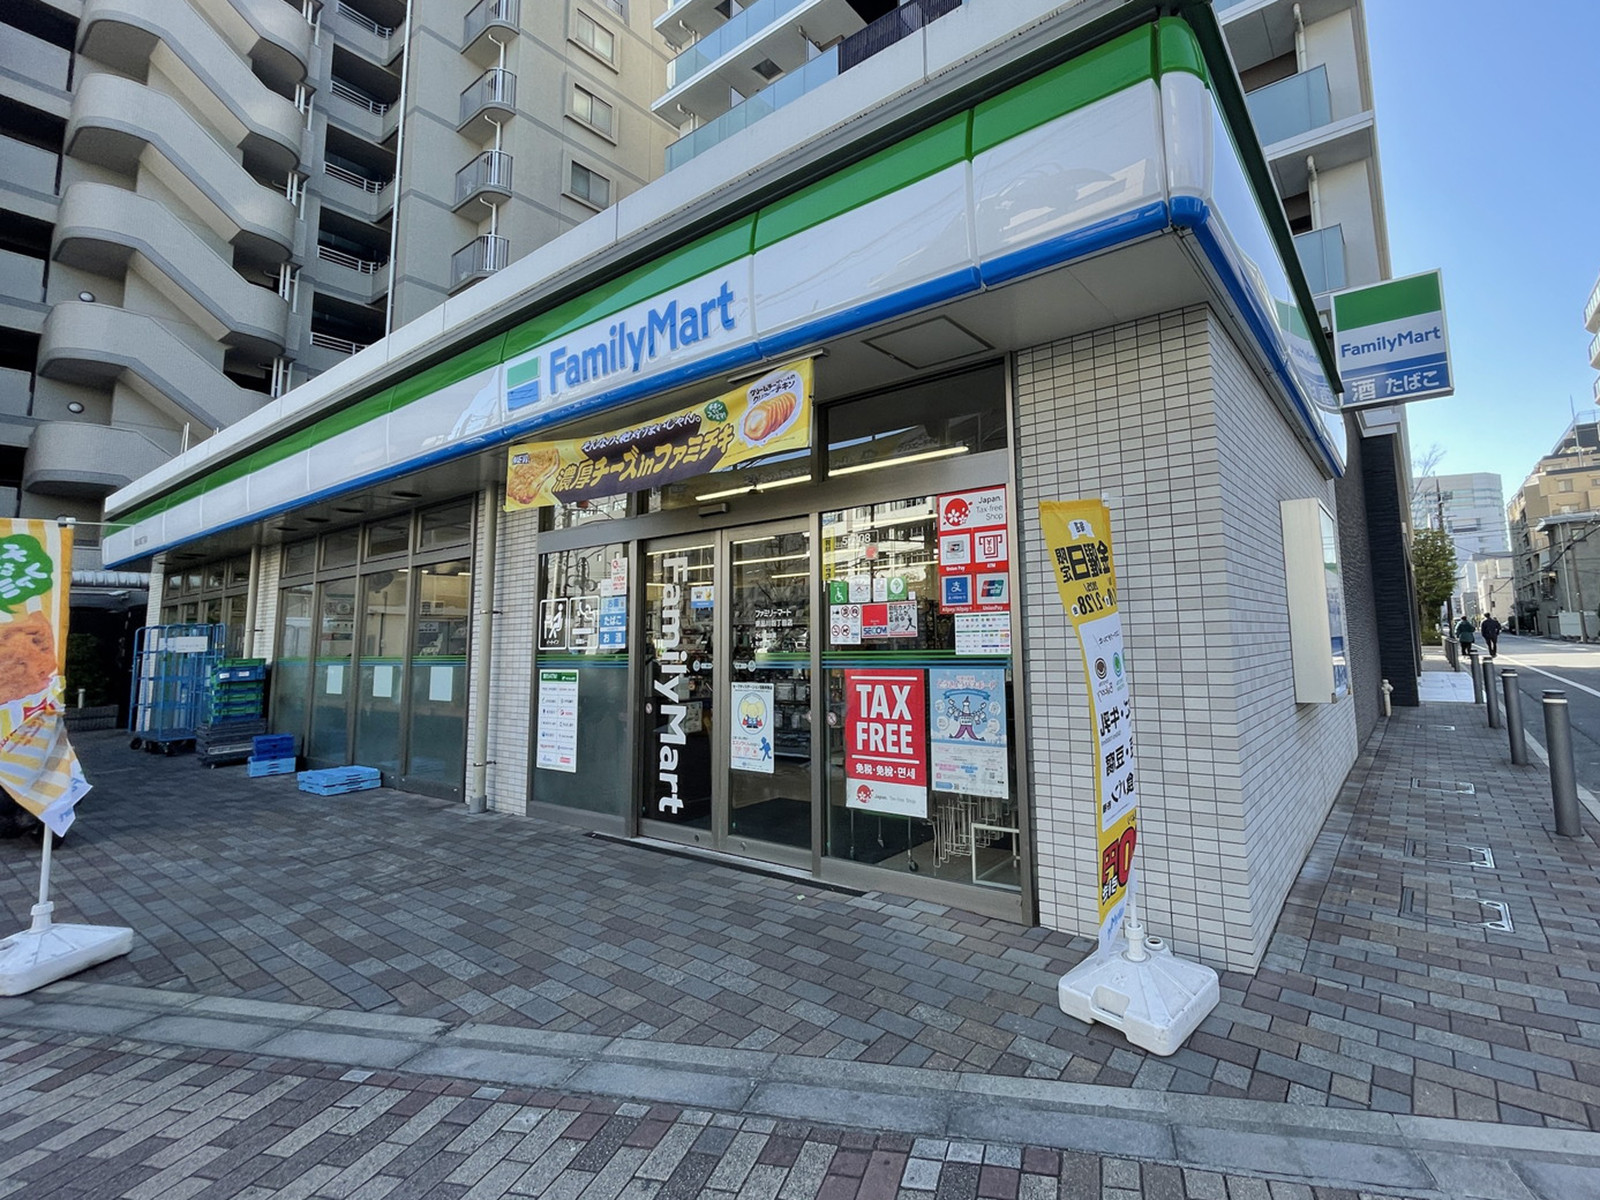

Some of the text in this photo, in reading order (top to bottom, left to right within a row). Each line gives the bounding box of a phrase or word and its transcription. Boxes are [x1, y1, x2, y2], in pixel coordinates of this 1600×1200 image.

[550, 281, 735, 395] FamilyMart
[1341, 326, 1441, 358] FamilyMart
[1351, 378, 1376, 402] 酒
[1385, 370, 1440, 394] たばこ
[552, 423, 735, 492] 濃厚チーズinファミチキ
[986, 512, 1003, 521] Shop
[603, 615, 622, 626] たばこ
[755, 608, 792, 618] ファミリーマート
[863, 626, 887, 635] SECOM
[653, 555, 689, 815] FamilyMart
[855, 683, 912, 721] TAX
[856, 721, 914, 755] FREE
